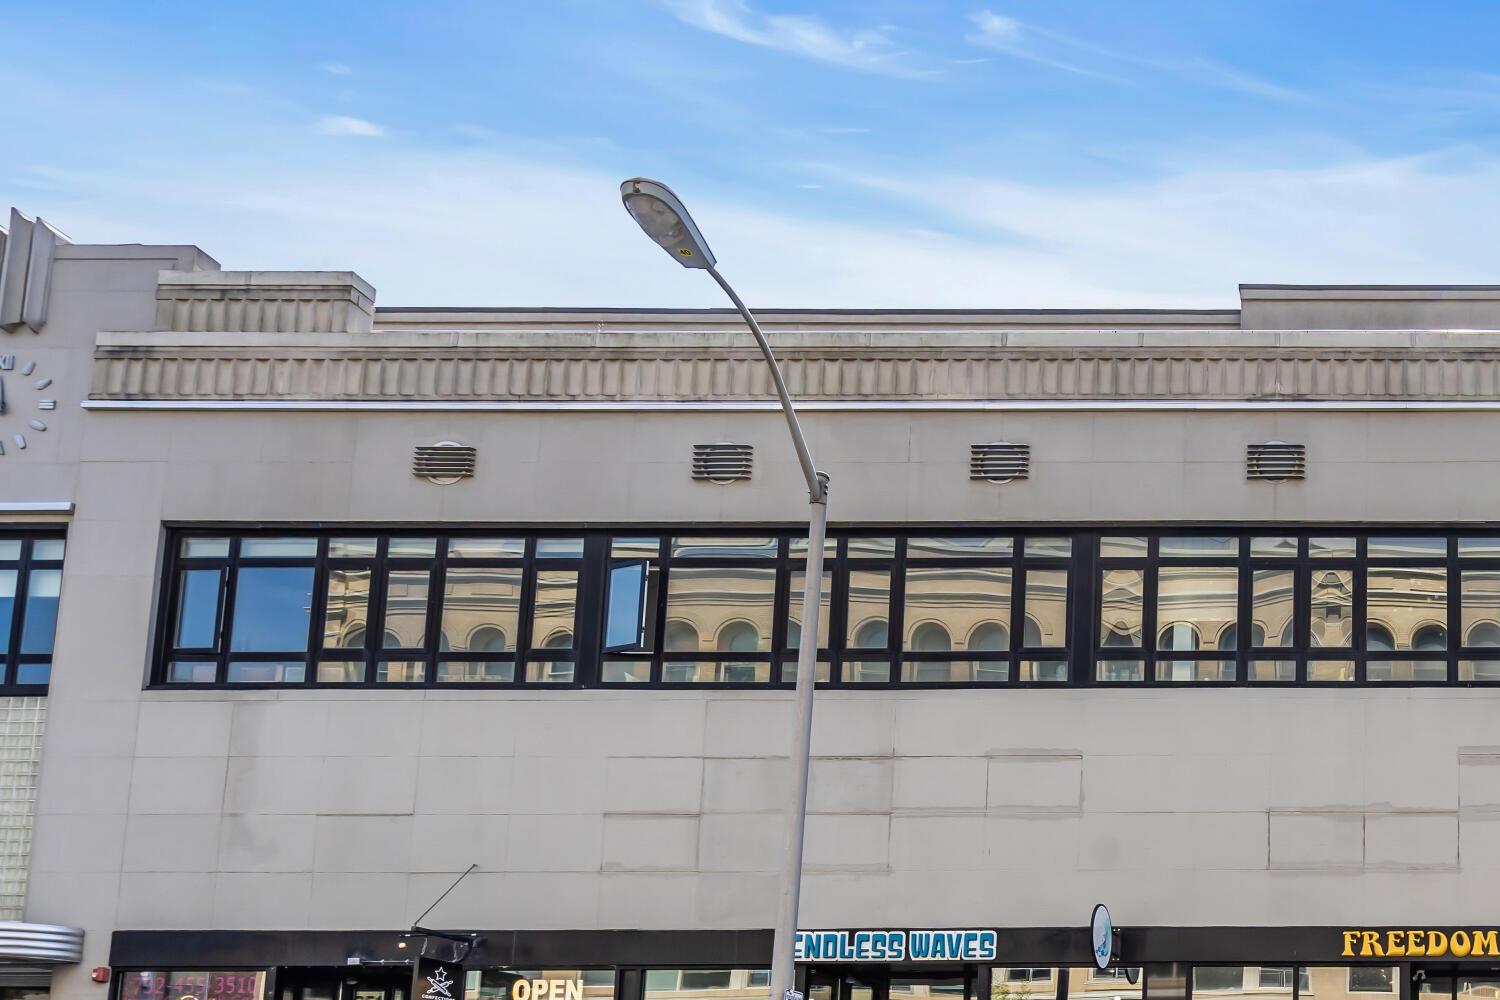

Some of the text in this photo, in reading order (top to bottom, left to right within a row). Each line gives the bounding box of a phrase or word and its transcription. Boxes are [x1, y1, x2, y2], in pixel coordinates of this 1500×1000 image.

[794, 930, 997, 961] ENDLESS WAVES
[1341, 930, 1500, 957] FREEDOM
